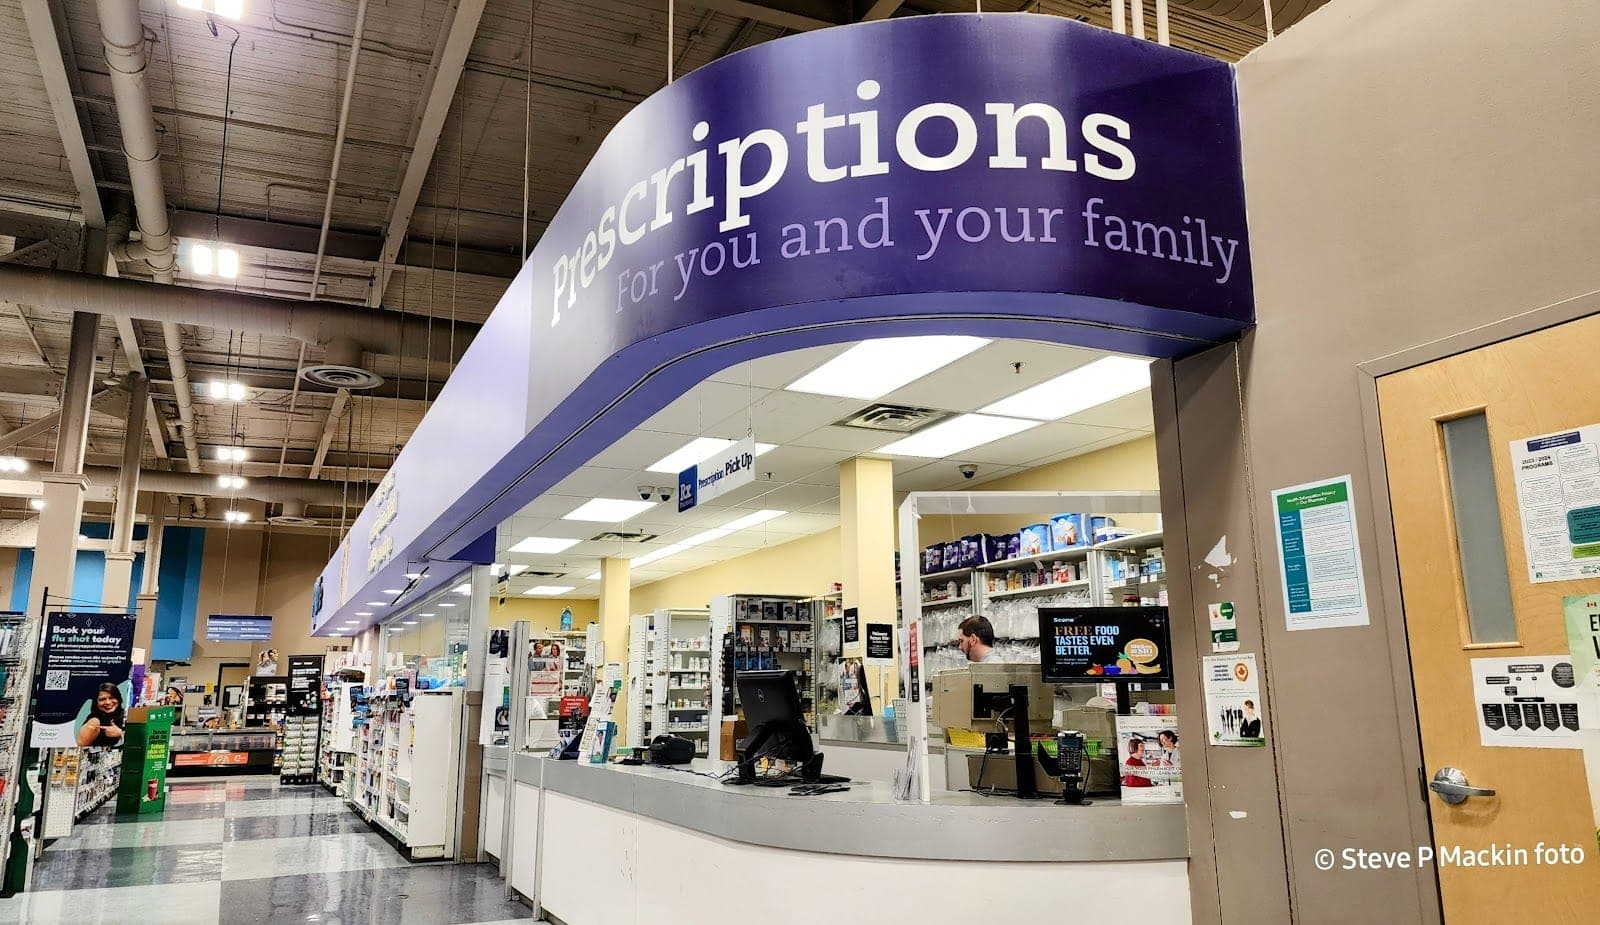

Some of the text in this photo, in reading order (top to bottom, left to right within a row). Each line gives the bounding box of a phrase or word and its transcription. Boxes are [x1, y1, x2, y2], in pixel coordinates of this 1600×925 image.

[550, 80, 1137, 329] Prescriptions
[614, 197, 1239, 316] For you and your family
[698, 452, 753, 489] Prescription Pick Up
[680, 483, 692, 501] Rx
[52, 625, 105, 636] Book your
[1055, 626, 1119, 636] FREE FOOD
[51, 634, 122, 645] flu shot today
[1054, 636, 1114, 645] TASTES EVEN
[1055, 645, 1092, 655] BETTER.
